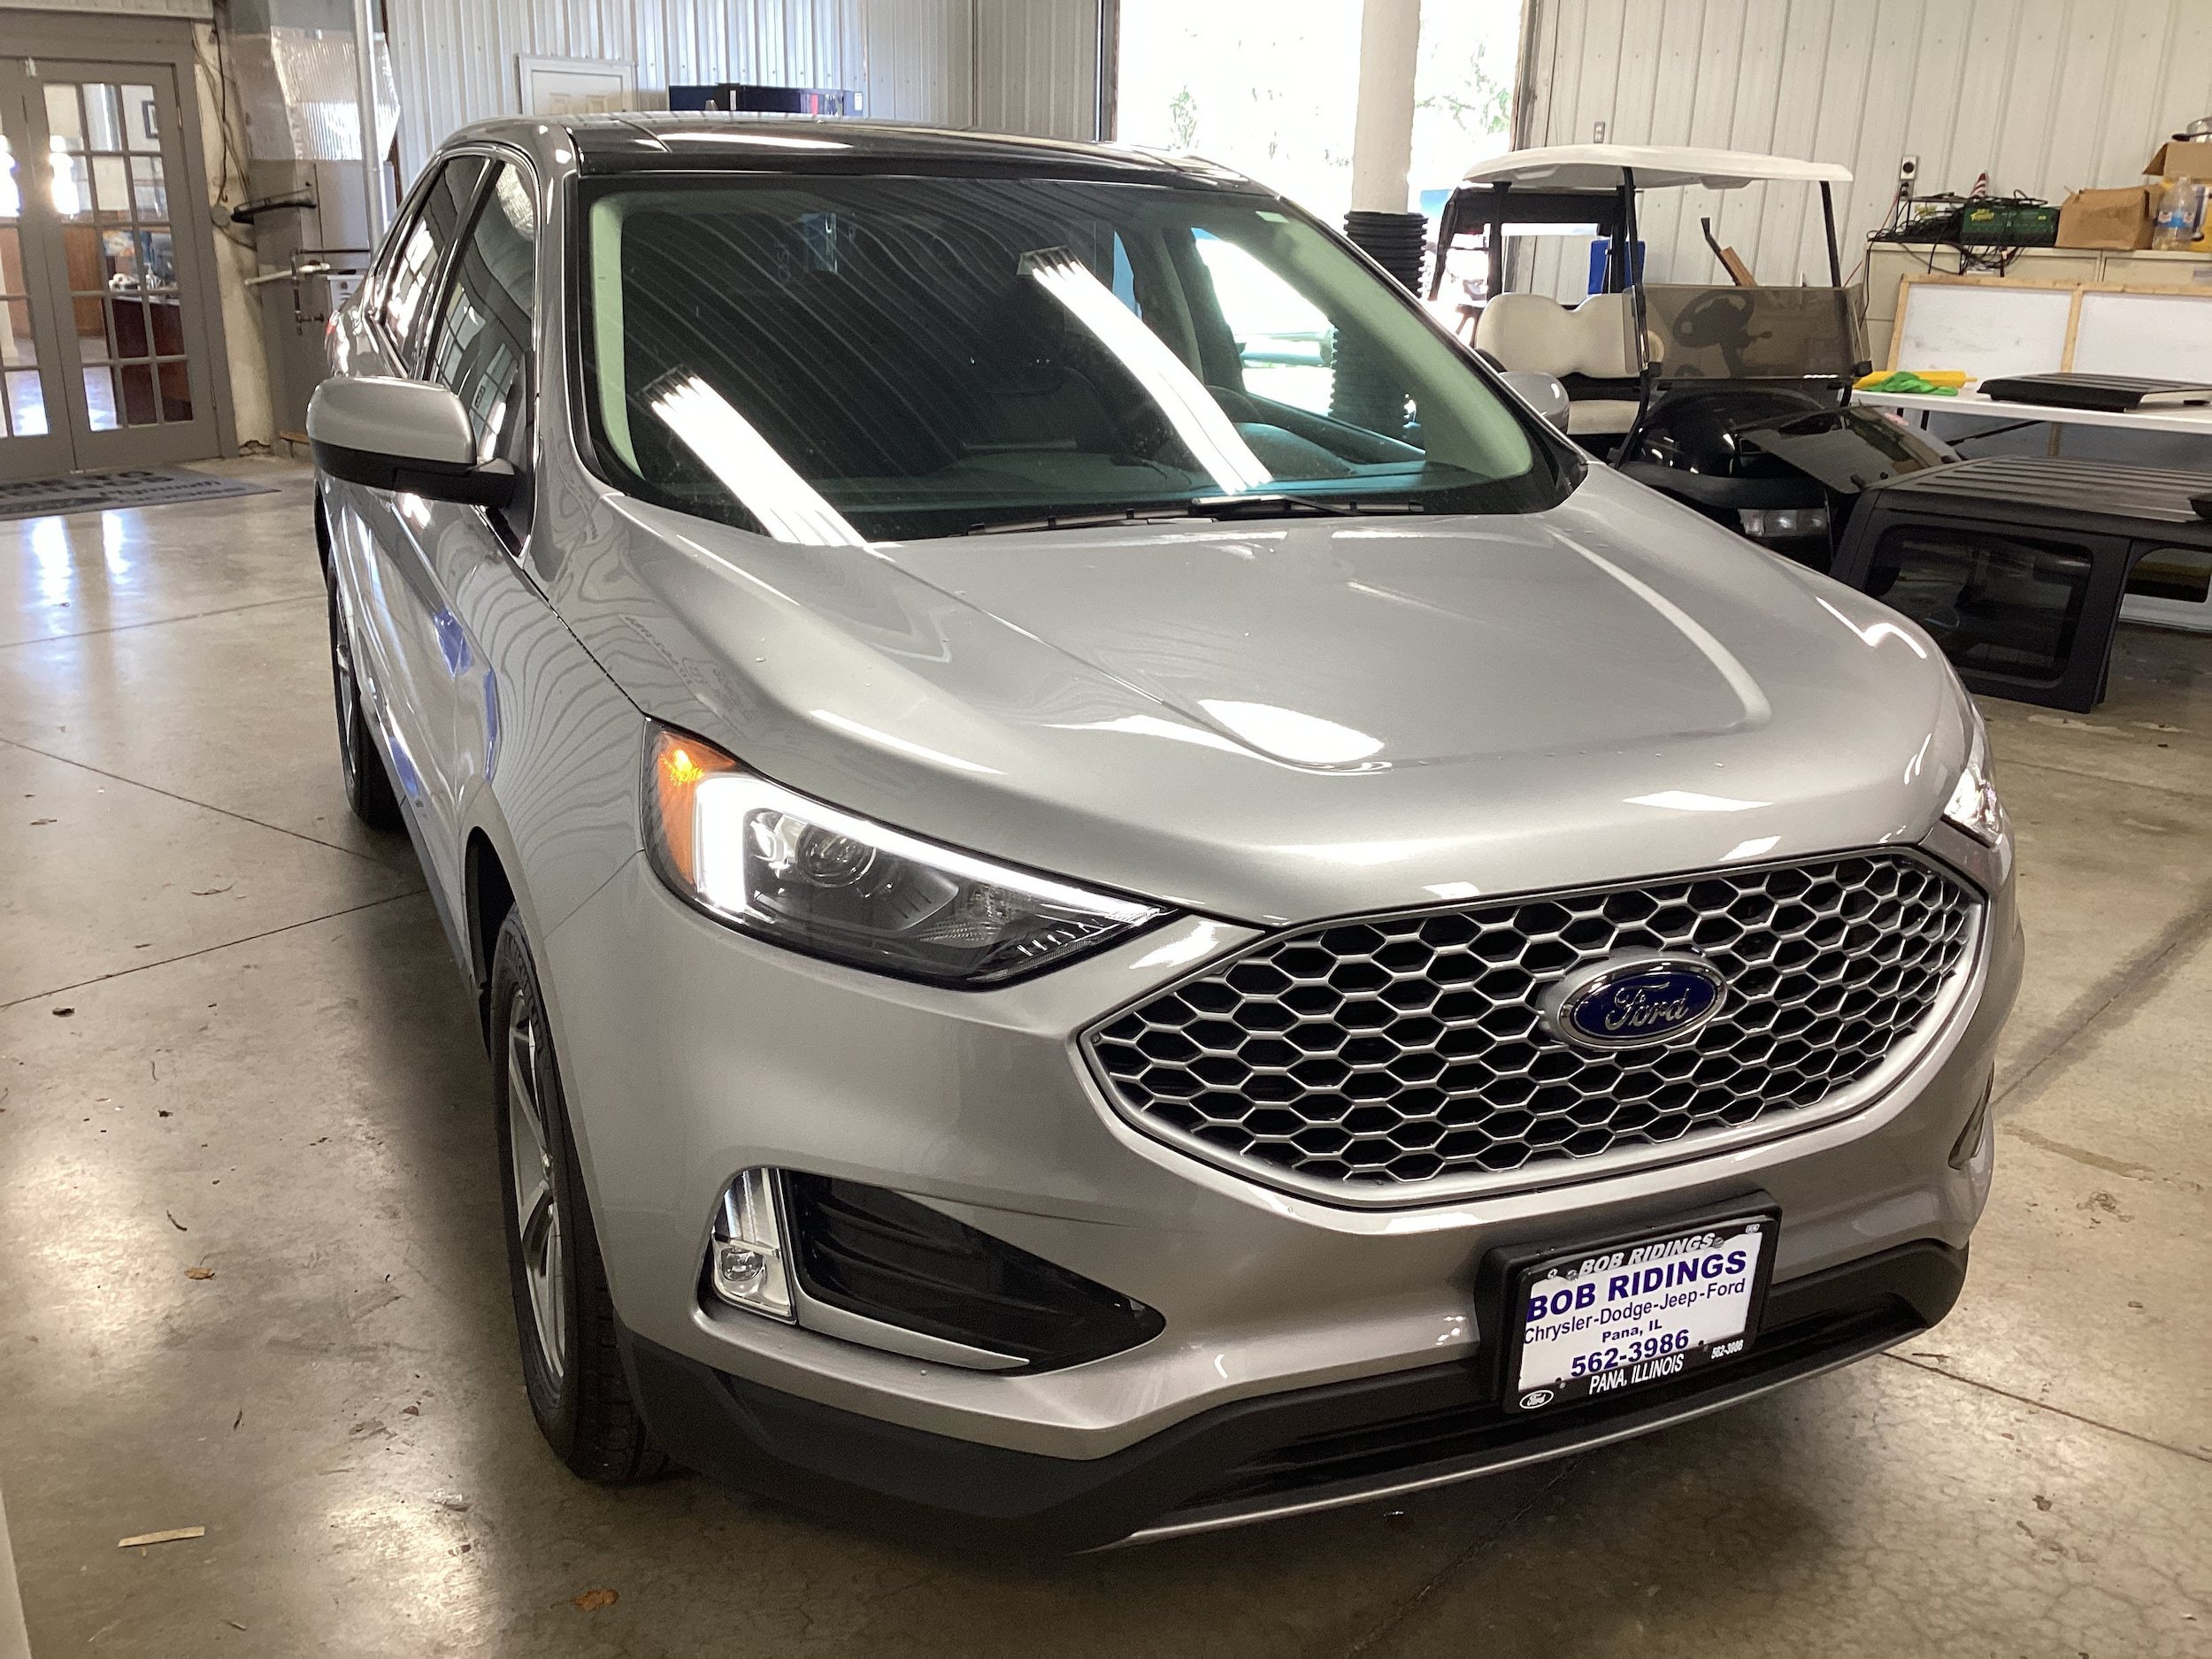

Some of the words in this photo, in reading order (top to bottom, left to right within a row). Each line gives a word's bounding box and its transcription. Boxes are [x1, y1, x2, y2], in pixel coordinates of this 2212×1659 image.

[1604, 979, 1691, 1032] Ford
[1578, 1252, 1624, 1277] BOB
[1628, 1233, 1716, 1266] RIDINGS
[1526, 1283, 1596, 1324] BOB
[1608, 1250, 1747, 1302] RIDINGS
[1571, 1329, 1689, 1378] 562-3986
[1601, 1326, 1643, 1343] Pana,
[1648, 1318, 1663, 1332] IL
[1588, 1368, 1628, 1395] PANA,
[1631, 1353, 1685, 1384] ILLINOIS
